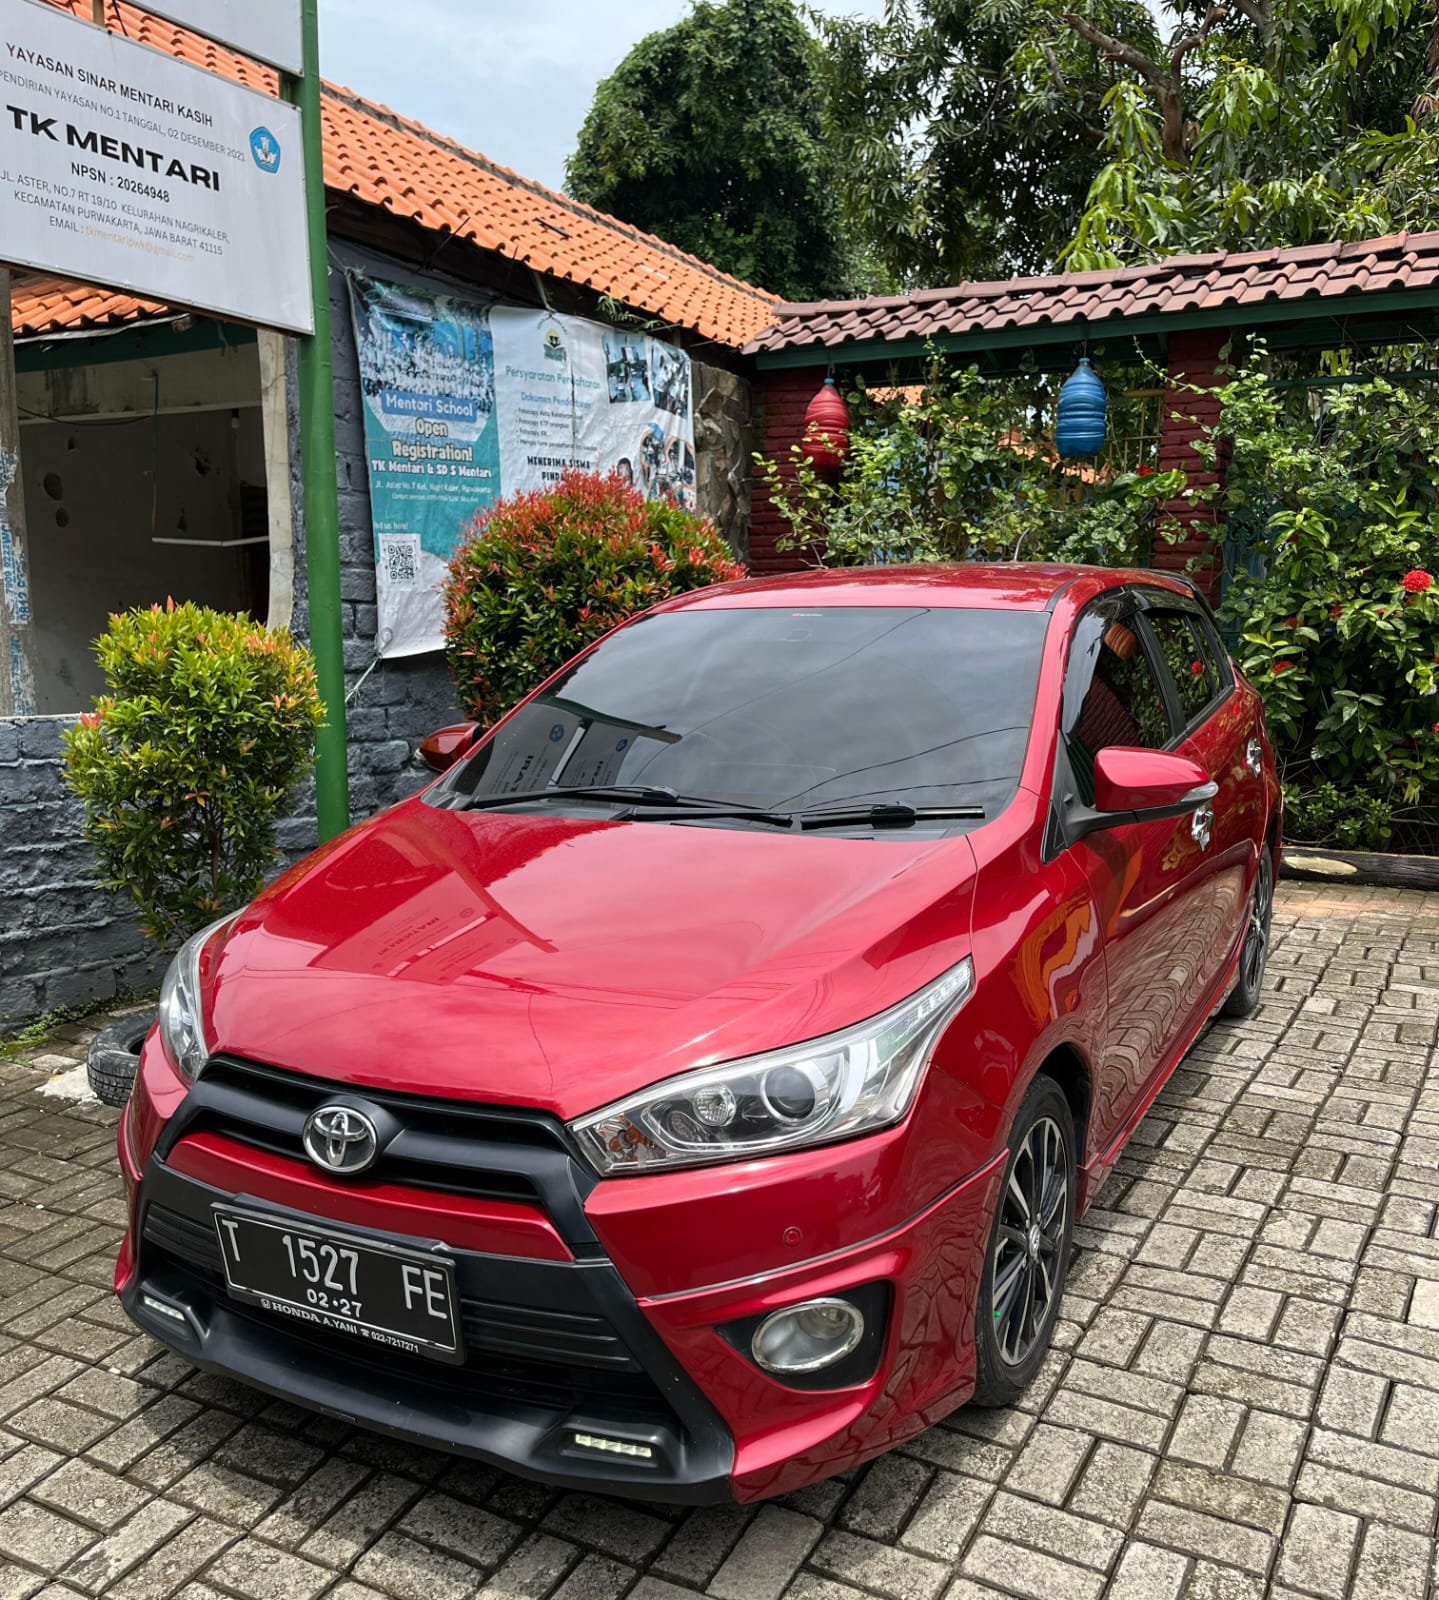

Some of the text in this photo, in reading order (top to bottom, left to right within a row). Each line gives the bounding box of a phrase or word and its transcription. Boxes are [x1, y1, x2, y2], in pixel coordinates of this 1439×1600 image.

[6, 42, 213, 128] YAYASAN SINAR MENTARI KASIH
[54, 89, 98, 112] YAYASAN
[122, 112, 166, 137] TANGGAL,
[168, 128, 179, 140] 02
[181, 132, 225, 156] DESEMBER
[227, 147, 246, 162] 2021
[6, 104, 220, 192] TK MENTARI
[71, 162, 106, 184] NPSN
[117, 176, 170, 203] 20264948
[14, 190, 223, 256] KECAMATAN PURWAKARTA, JAWA BARAT 41115
[17, 174, 51, 194] ASTER,
[53, 184, 76, 198] NO.7
[78, 191, 89, 202] RT
[92, 195, 117, 210] 19/10
[121, 204, 173, 228] KELURAHAN
[175, 219, 230, 244] NAGRIKALER,
[49, 216, 79, 233] EMAIL
[505, 365, 555, 383] Persyaratan
[385, 393, 473, 417] Mentari School
[416, 417, 448, 437] Open
[372, 460, 493, 479] TK Mentari & SD S Mentari
[392, 440, 474, 461] Registration!
[527, 456, 590, 469] MENERIMA SISWA
[221, 1219, 448, 1319] T 1527 FE
[272, 1301, 321, 1323] HONDA
[371, 1330, 419, 1354] 022-7217271
